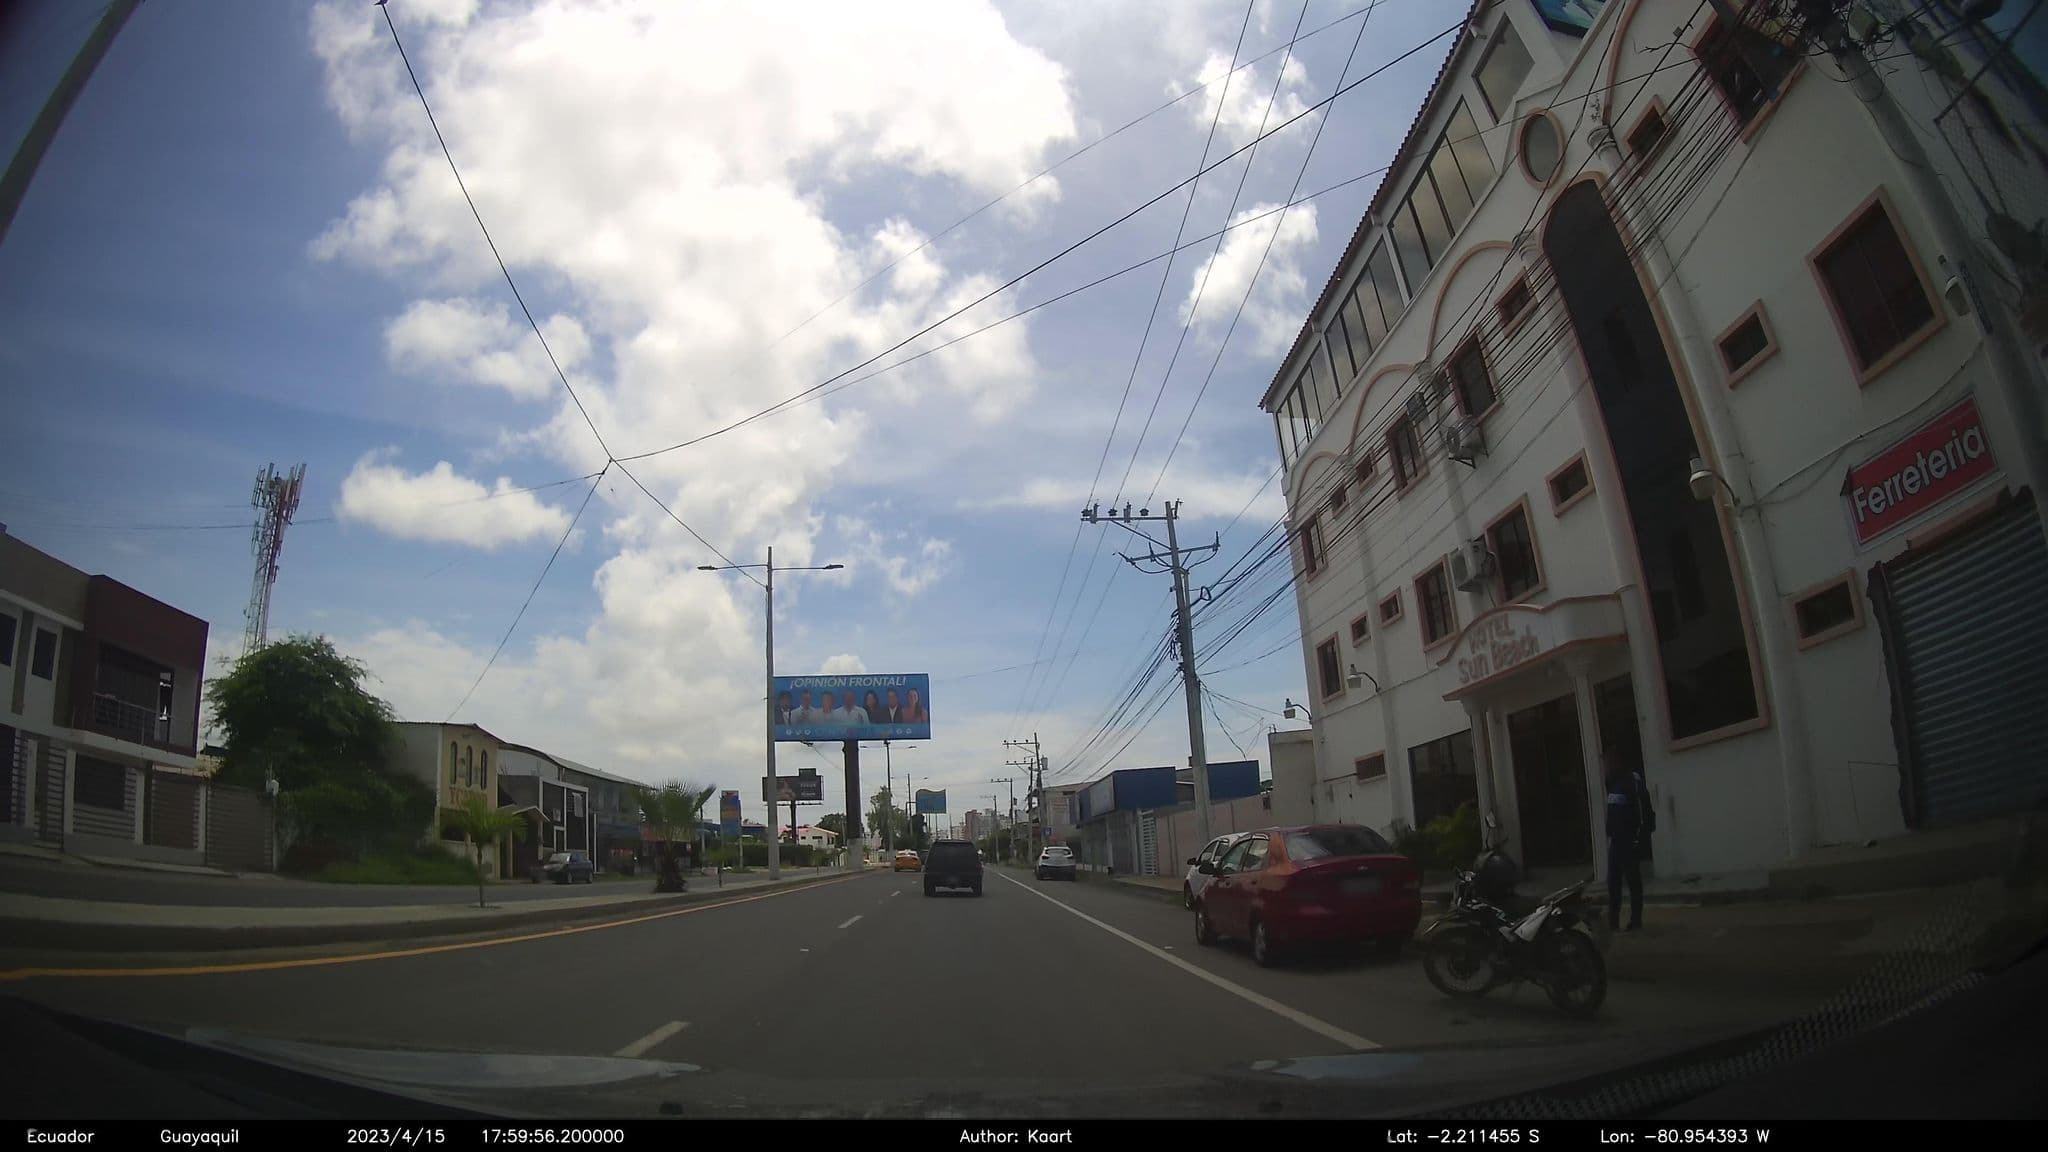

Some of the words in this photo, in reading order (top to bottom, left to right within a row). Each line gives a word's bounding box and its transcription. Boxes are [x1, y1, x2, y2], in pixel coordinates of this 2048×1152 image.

[1468, 612, 1515, 654] HOTEL
[790, 675, 846, 689] ¡OPINIÓN
[848, 676, 906, 687] FRONTAL!
[1458, 656, 1490, 683] Sun
